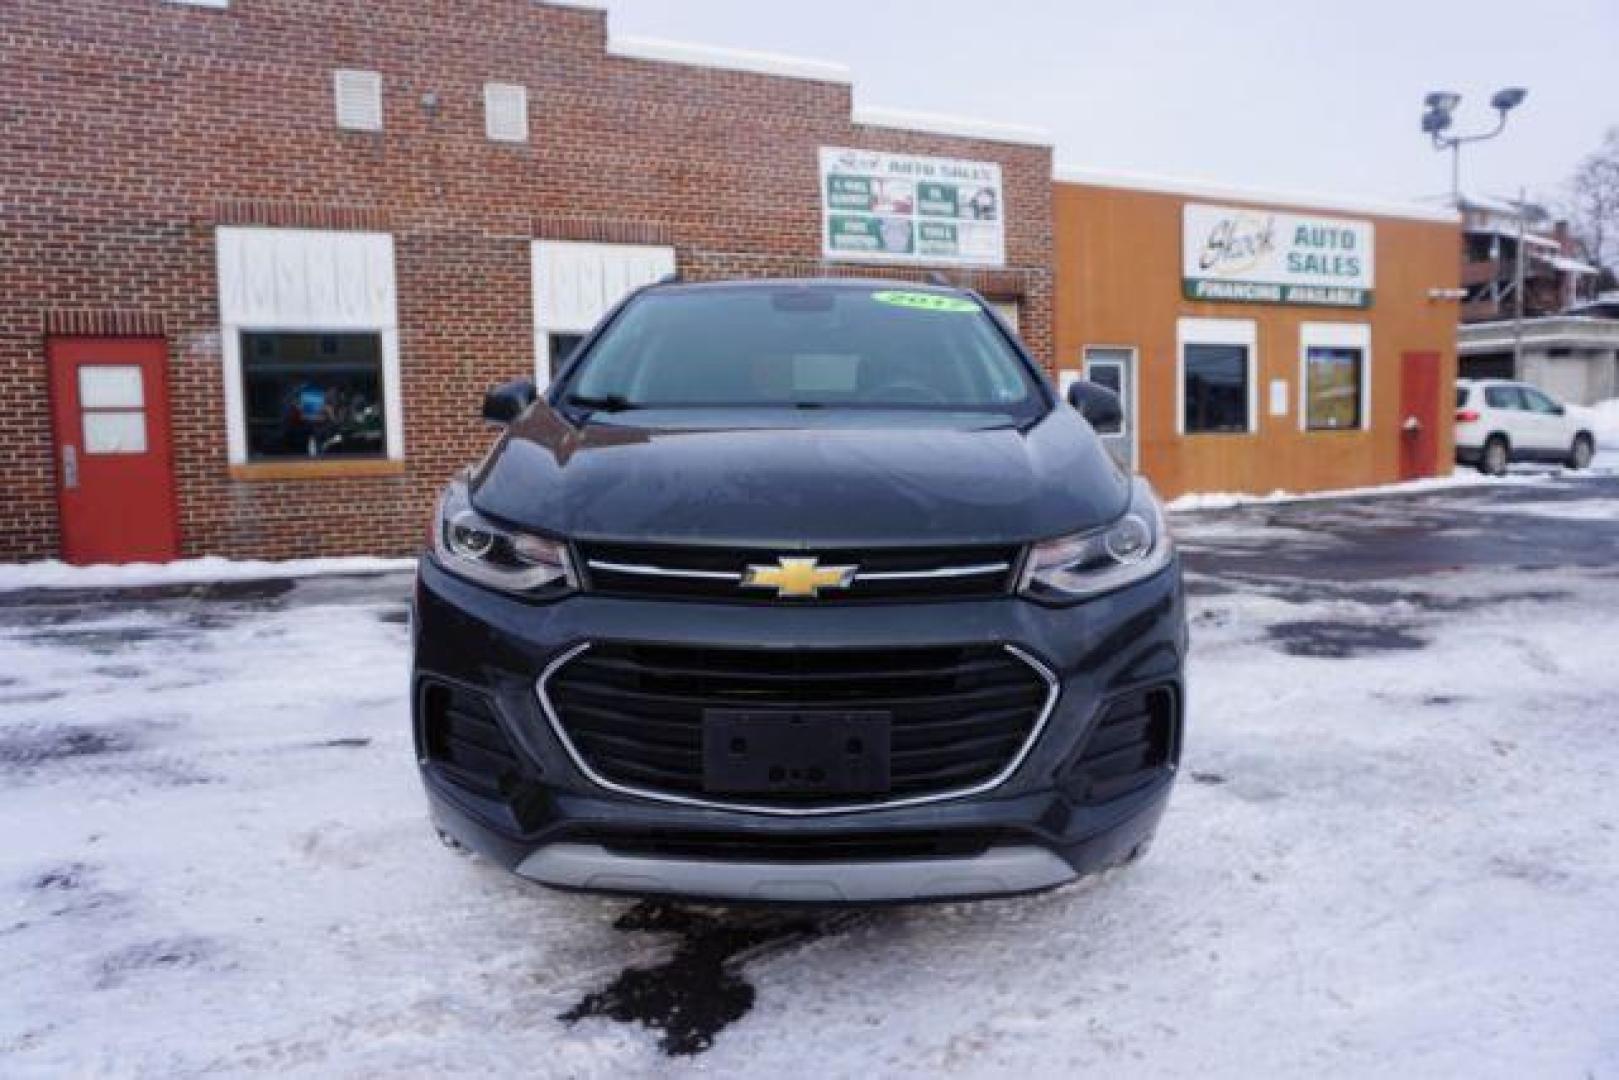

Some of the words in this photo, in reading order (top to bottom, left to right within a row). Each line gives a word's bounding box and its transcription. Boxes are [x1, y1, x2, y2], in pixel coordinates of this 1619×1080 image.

[888, 161, 934, 176] AUTO
[940, 165, 992, 181] SALES
[1294, 224, 1357, 249] AUTO
[1287, 252, 1361, 277] SALES
[1197, 281, 1280, 300] FINANCING
[1288, 286, 1362, 305] AVAILABLE
